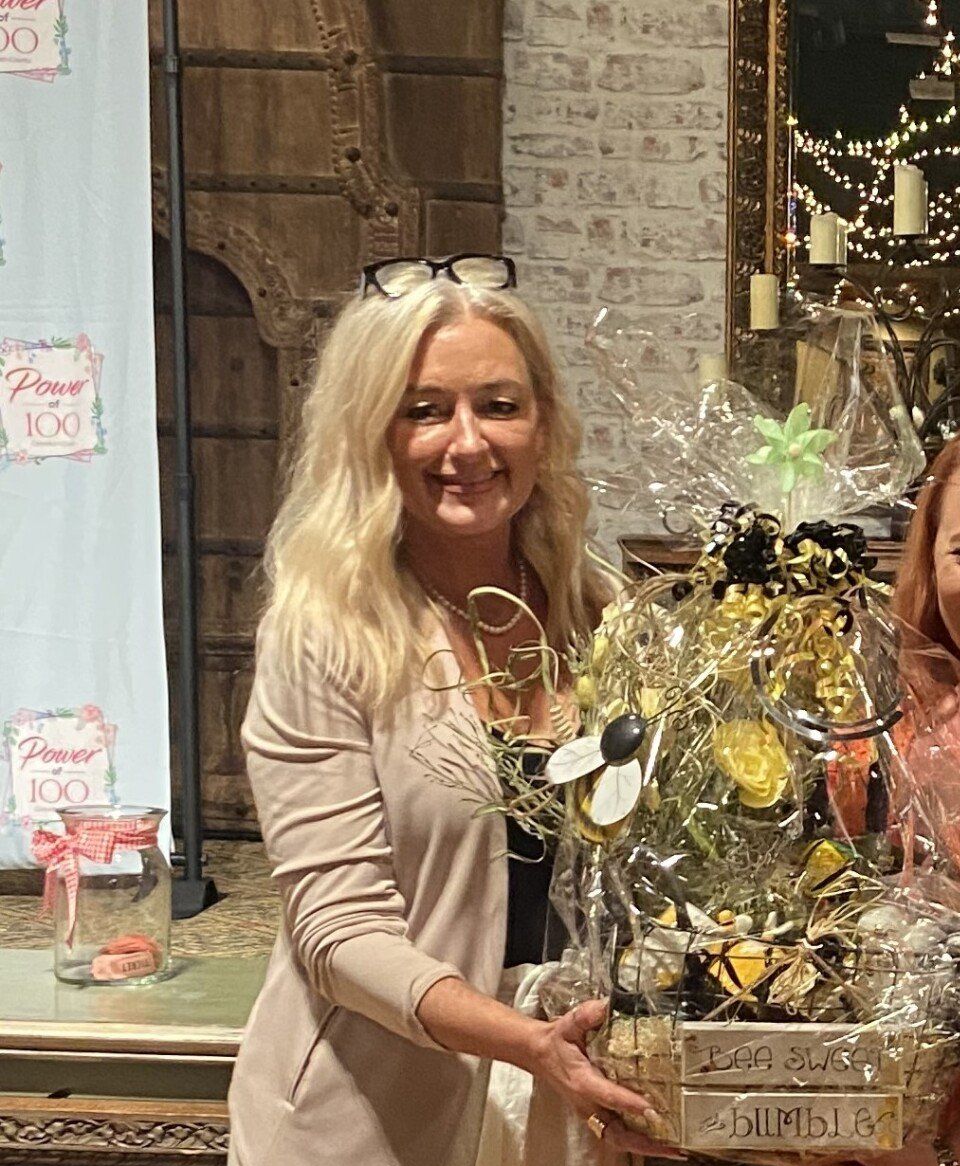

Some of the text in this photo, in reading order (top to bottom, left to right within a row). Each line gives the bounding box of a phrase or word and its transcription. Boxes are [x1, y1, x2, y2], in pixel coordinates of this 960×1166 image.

[5, 367, 90, 402] Power
[26, 412, 80, 438] 100
[18, 736, 103, 771] Power
[30, 778, 89, 804] 100
